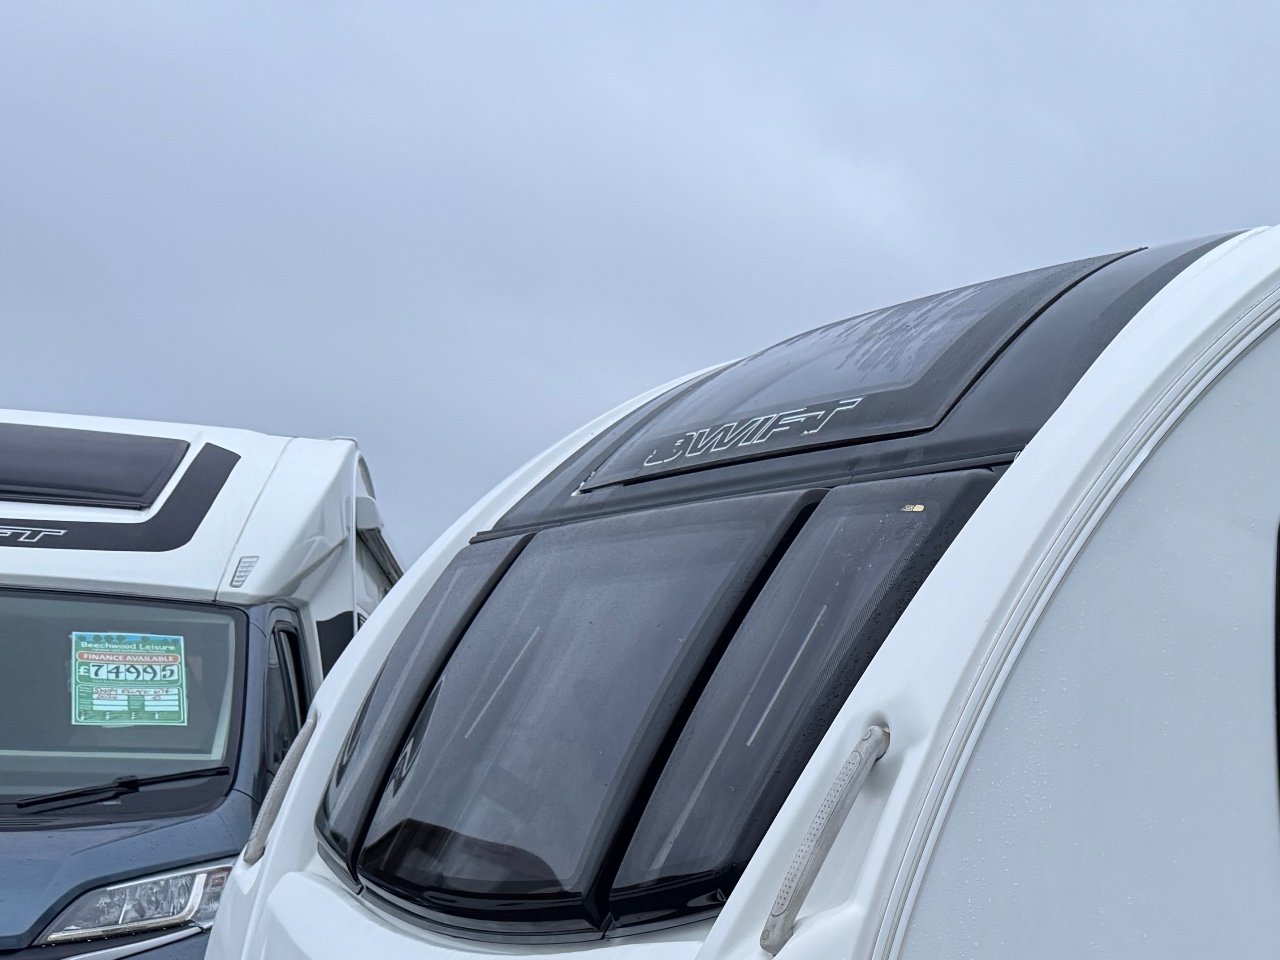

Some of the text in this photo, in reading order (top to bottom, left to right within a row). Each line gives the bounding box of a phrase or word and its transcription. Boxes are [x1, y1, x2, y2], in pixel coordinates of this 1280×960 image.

[643, 397, 864, 467] SWIFT
[80, 641, 136, 650] Beechwood
[139, 643, 175, 651] Leisure
[83, 653, 124, 661] FINANCE
